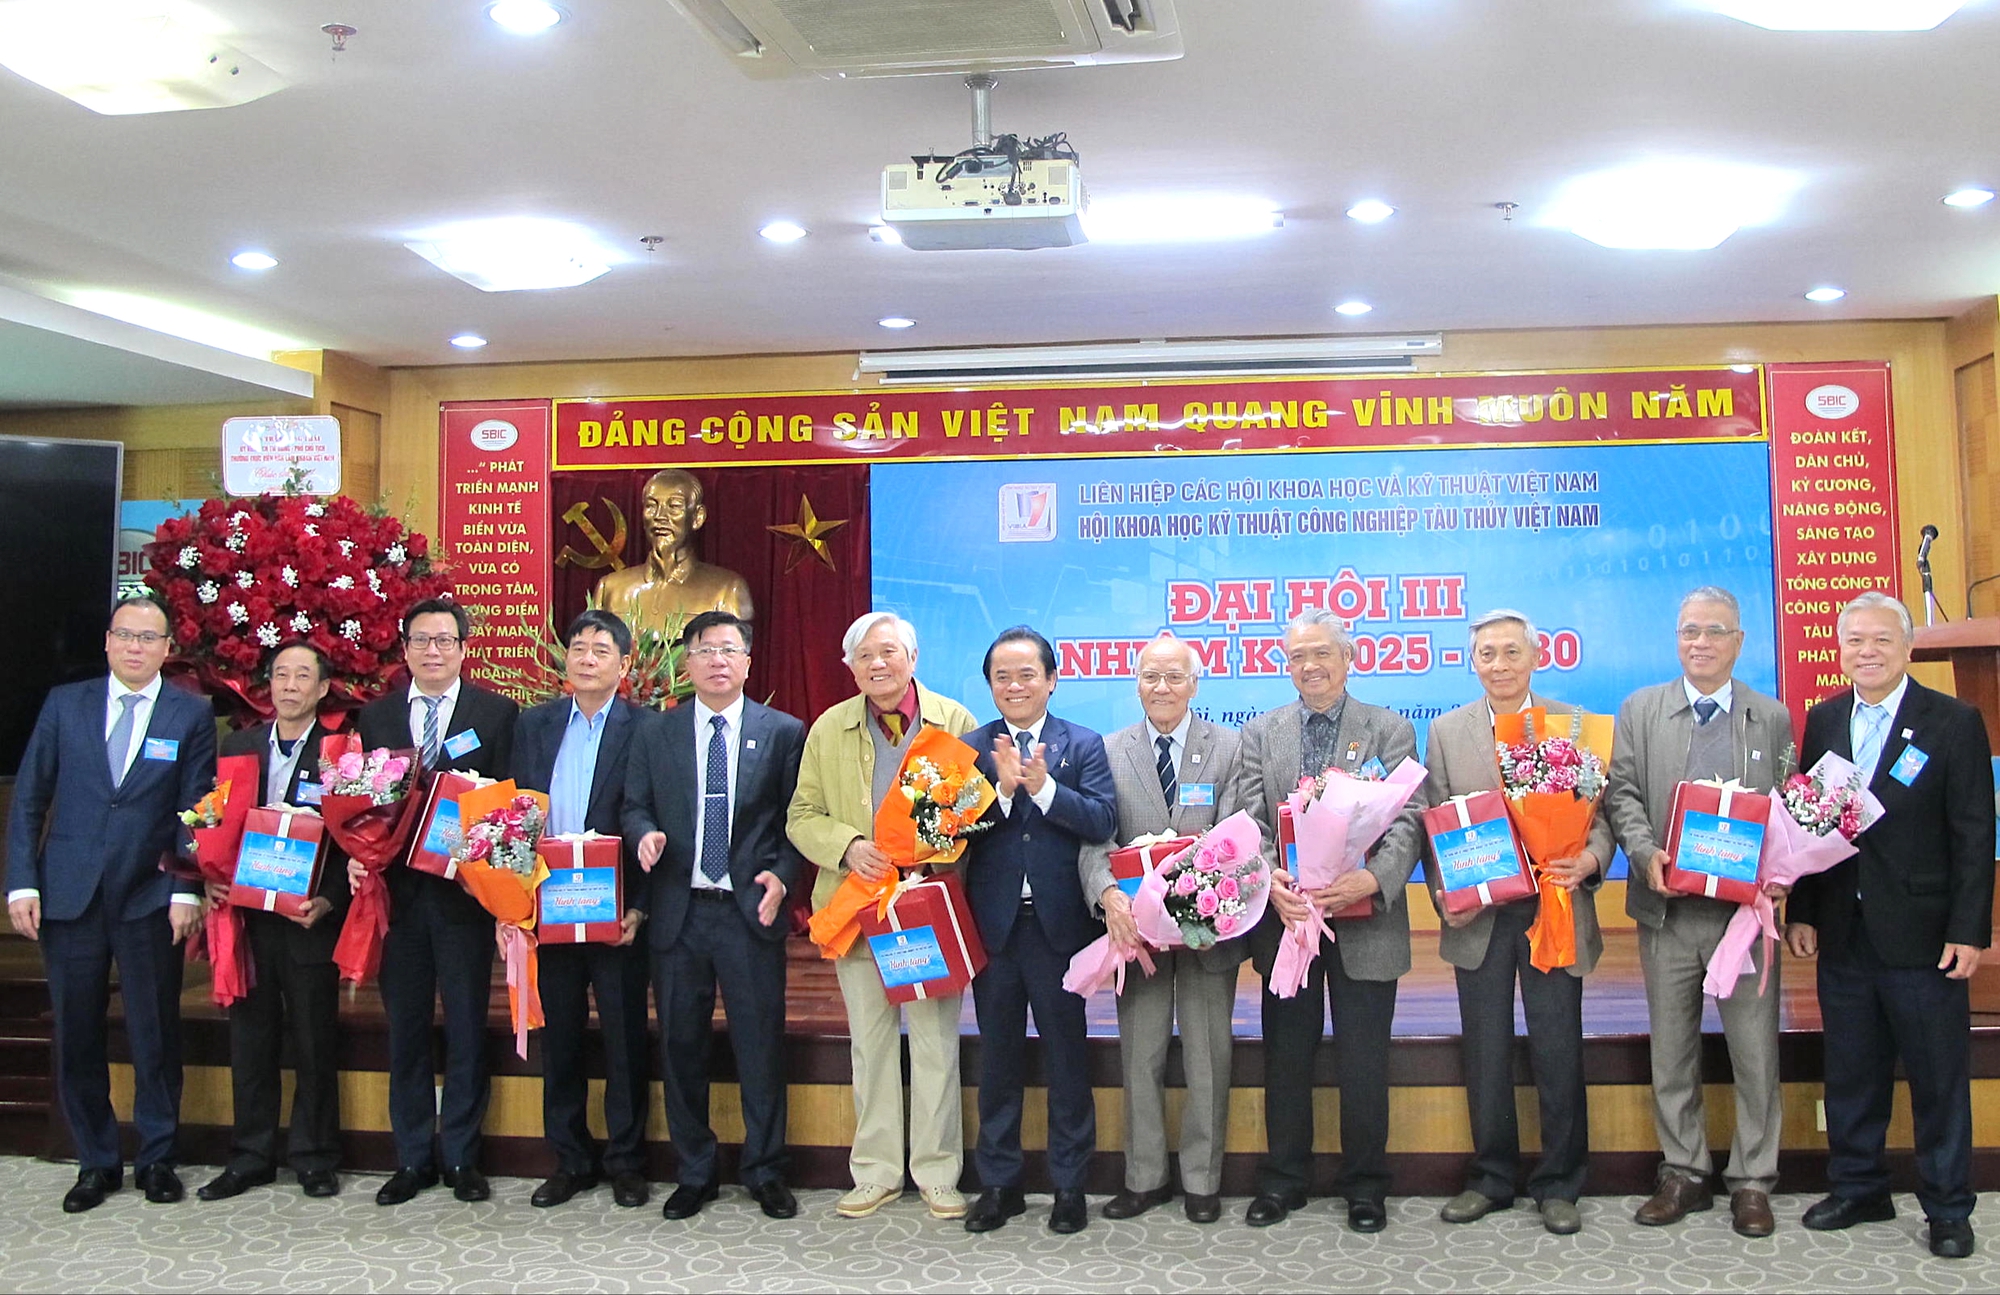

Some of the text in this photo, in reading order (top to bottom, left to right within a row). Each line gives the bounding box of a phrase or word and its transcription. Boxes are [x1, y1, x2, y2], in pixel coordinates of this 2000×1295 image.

[1817, 395, 1847, 406] SBIC
[578, 409, 686, 448] ĐẢNG
[701, 409, 813, 449] CỘNG
[832, 401, 920, 441] SẢN
[941, 402, 1035, 442] VIỆT
[1059, 403, 1160, 435] NAM
[1182, 400, 1329, 432] QUANG
[1477, 386, 1609, 424] MUÔN
[1631, 383, 1734, 420] NĂM
[481, 429, 507, 439] SBIC
[1790, 426, 1872, 445] ĐOÀN KẾT,
[490, 458, 525, 473] PHÁT
[1795, 451, 1870, 469] DÂN CHỦ,
[456, 478, 539, 496] TRIỂN MẠNH
[1079, 470, 1598, 506] LIÊN HIỆP CÁC HỘI KHOA HỌC VÀ KỸ THUẬT VIỆT NAM
[1815, 478, 1877, 493] CƯƠNG,
[469, 498, 523, 515] KINH TẾ
[1782, 499, 1887, 518] NĂNG ĐỘNG,
[463, 519, 527, 536] BIỂN VỪA
[1079, 500, 1599, 543] HỘI KHOA HỌC KỸ THUẬT CÔNG NGHIỆP TÀU THỦY VIỆT NAM
[1796, 524, 1875, 542] SÁNG TẠO
[455, 539, 535, 556] TOÀN DIỆN,
[469, 559, 520, 575] VỪA CÓ
[1796, 550, 1878, 568] XÂY DỰNG
[1785, 572, 1891, 590] TỔNG CÔNG TY
[455, 581, 539, 599] TRỌNG TÂM,
[505, 600, 540, 616] ĐIỂM
[1170, 570, 1463, 631] ĐẠI HỘI III
[1785, 599, 1831, 614] CÔNG
[1803, 623, 1833, 638] TÀU
[497, 642, 535, 658] TRIỂN
[1059, 632, 1228, 676] NHM
[1353, 636, 1430, 672] 025
[1798, 646, 1837, 663] PHÁT
[1398, 703, 1442, 720] năm
